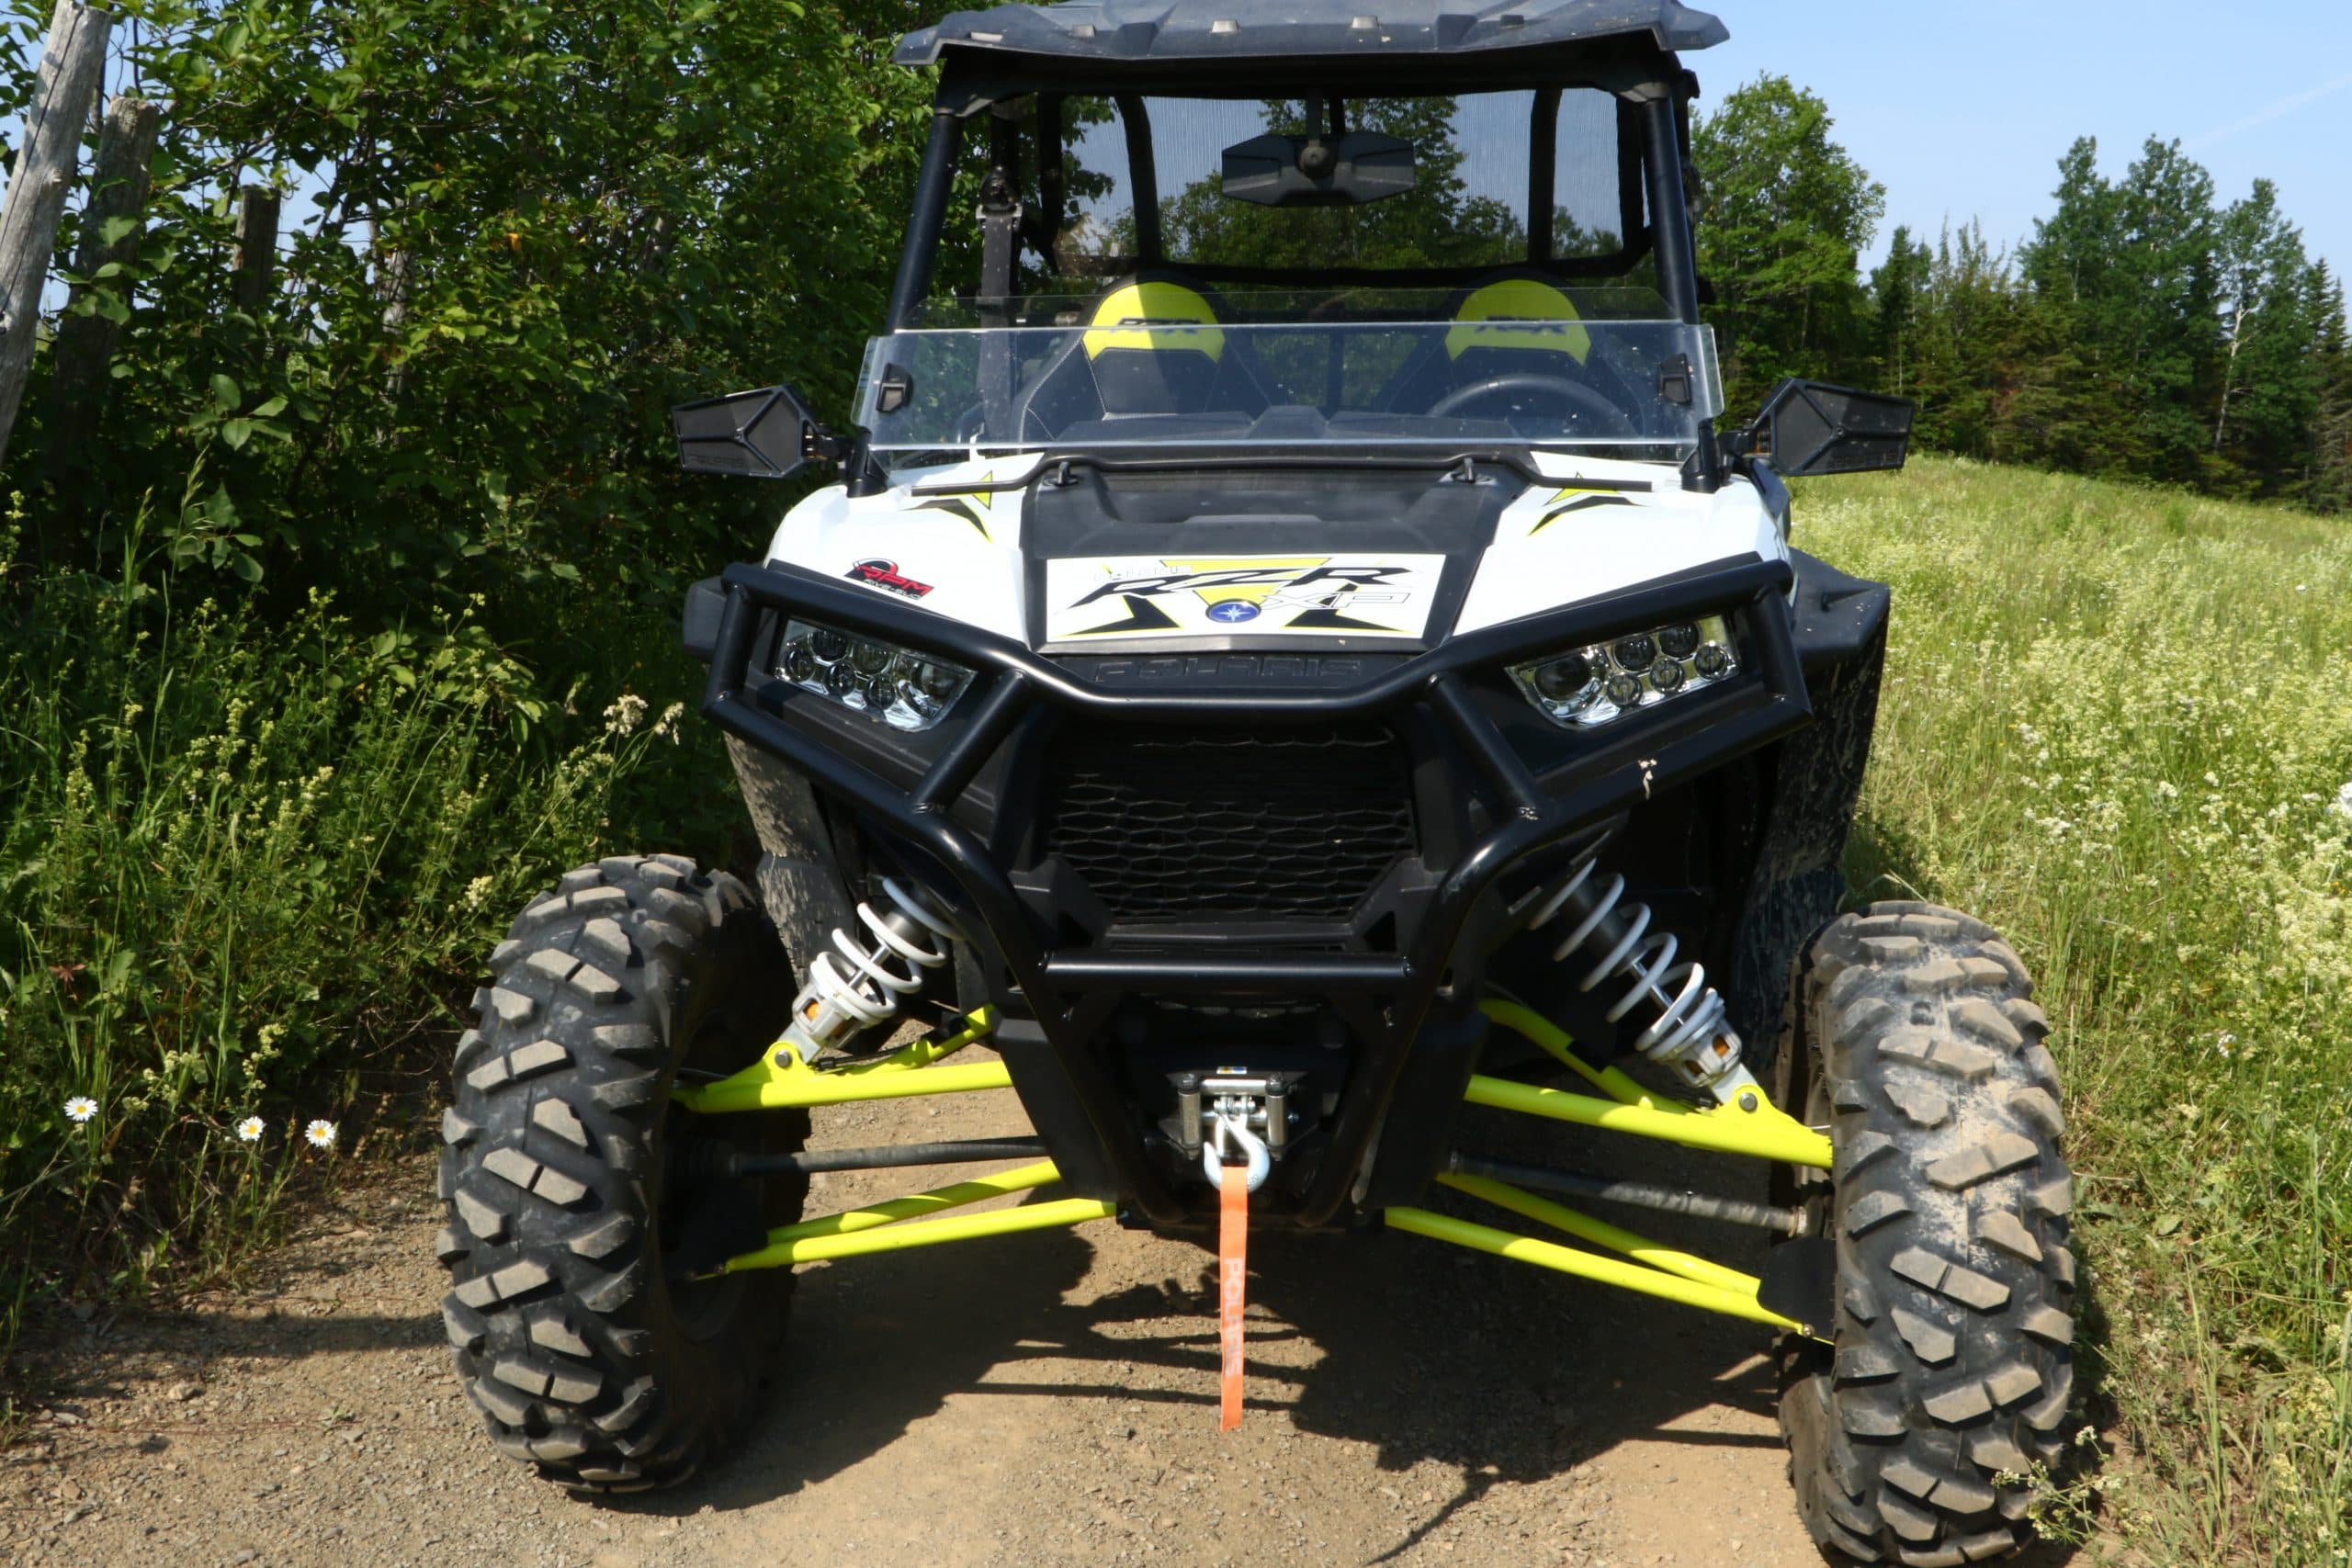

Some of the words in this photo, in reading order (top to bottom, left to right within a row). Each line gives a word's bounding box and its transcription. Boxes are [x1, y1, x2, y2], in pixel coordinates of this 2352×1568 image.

[1063, 567, 1417, 610] RZR
[1260, 591, 1412, 611] XP
[1094, 655, 1361, 682] POLARIS
[1223, 1257, 1244, 1377] POLARIS
